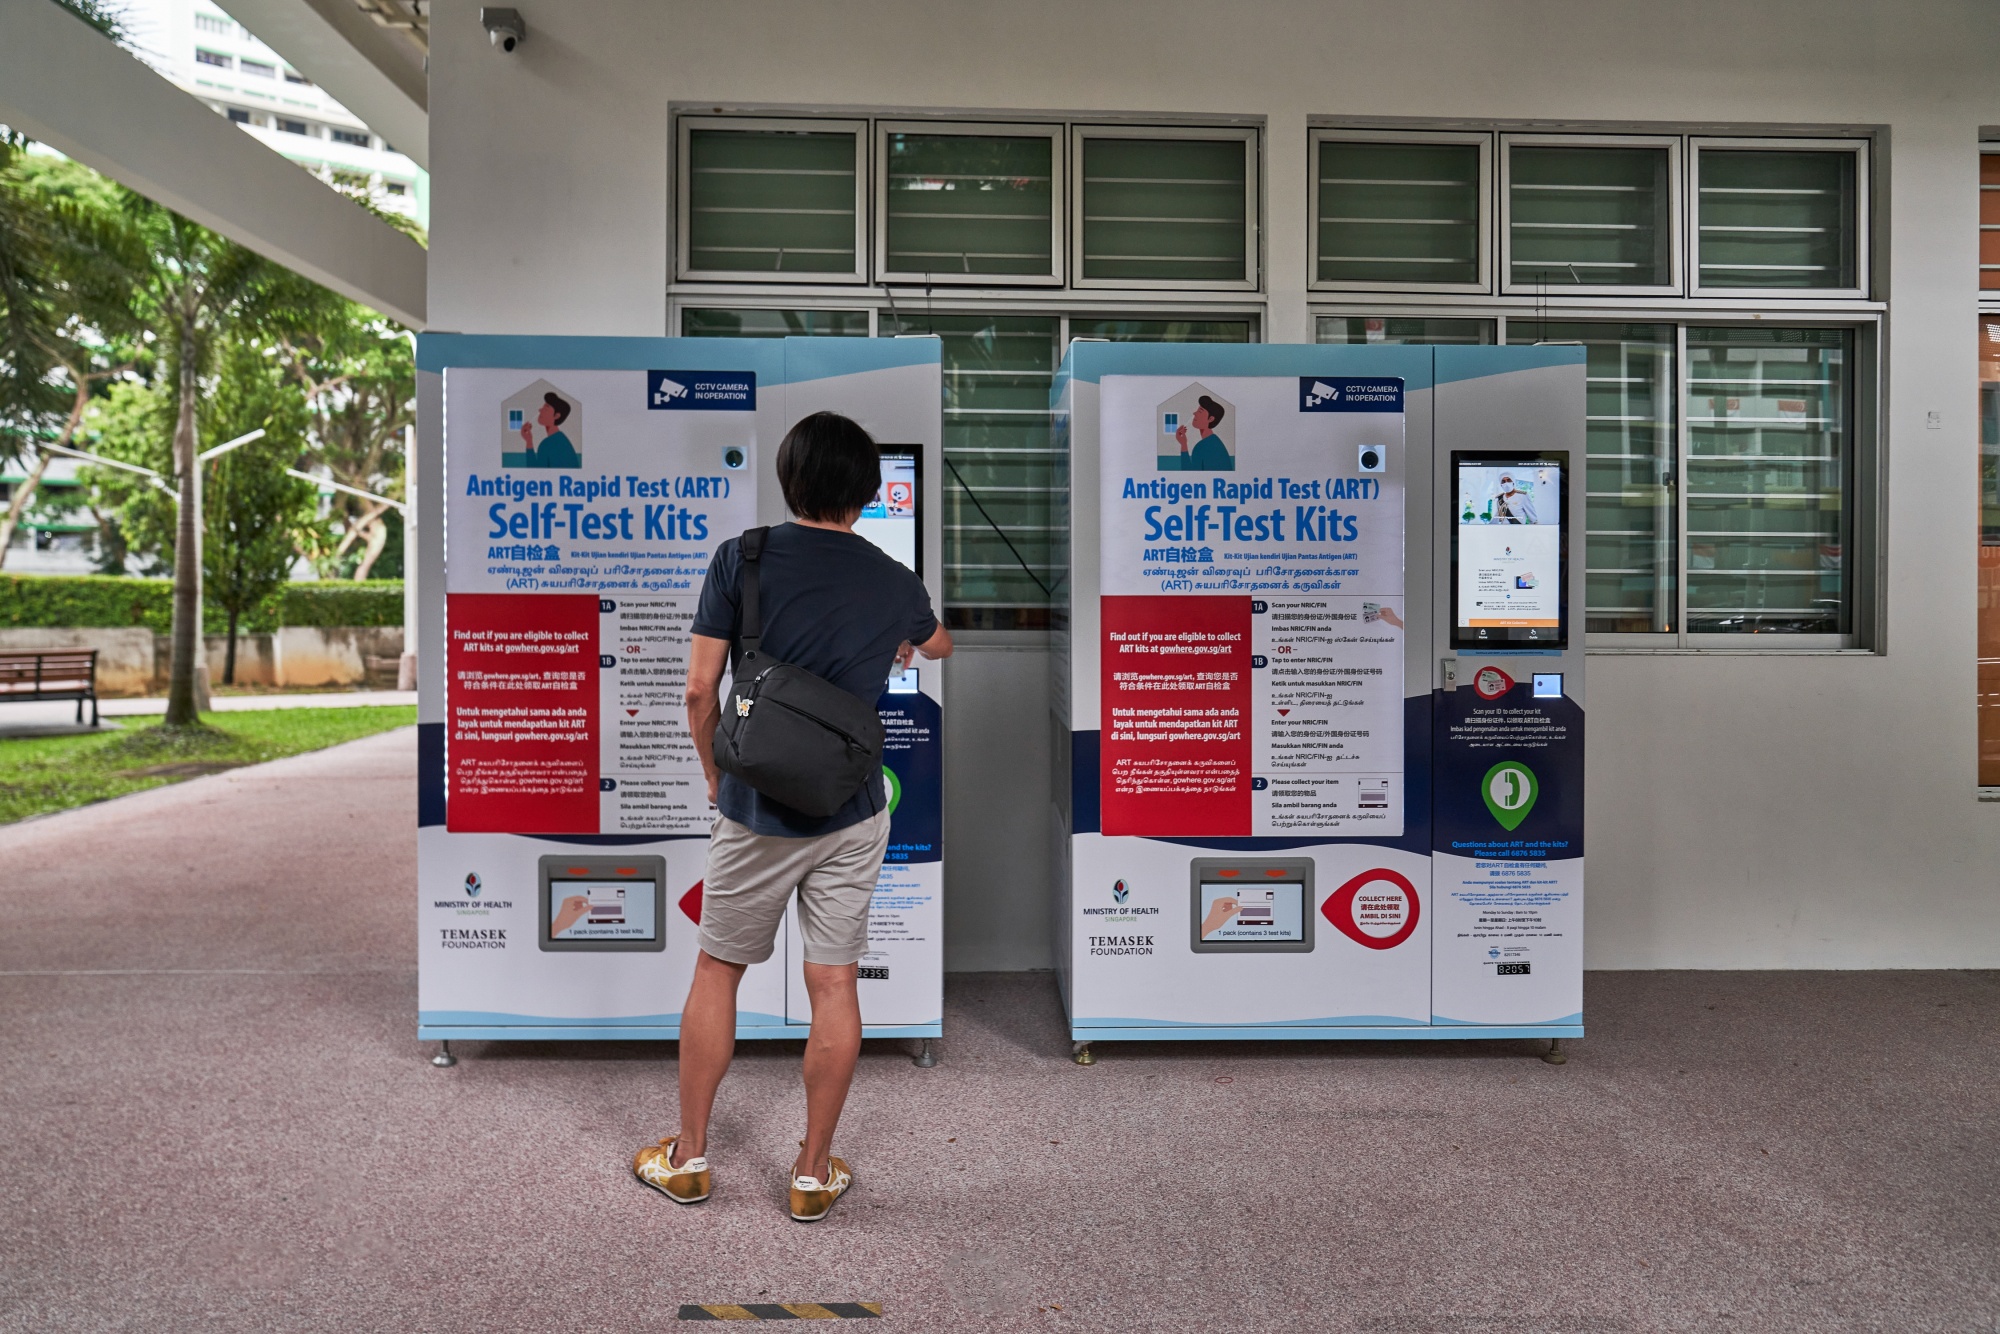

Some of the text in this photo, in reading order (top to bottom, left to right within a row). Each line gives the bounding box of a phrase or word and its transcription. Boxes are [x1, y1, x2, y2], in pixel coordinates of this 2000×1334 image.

[695, 383, 716, 393] CCTV
[704, 392, 746, 400] OPERATION
[467, 474, 730, 502] Antigen Rapid Test (ART)
[1123, 477, 1379, 504] Antigen Rapid Test (ART)
[489, 504, 708, 540] Self-Test Kits
[1145, 505, 1358, 542] Self-Test Kits
[488, 544, 560, 561] ART自检盒
[1143, 547, 1214, 563] ART自检盒
[1282, 553, 1297, 561] Ujian
[1319, 553, 1342, 561] Antigen
[1162, 580, 1192, 592] (ART)
[454, 630, 471, 640] Find
[472, 632, 485, 640] out
[487, 630, 493, 640] if
[494, 633, 508, 642] you
[524, 631, 552, 642] eligible
[554, 632, 562, 640] to
[564, 631, 588, 640] collect
[1110, 632, 1126, 641] Find
[1128, 633, 1141, 641] out
[1142, 632, 1148, 641] if
[1149, 634, 1163, 643] you
[1178, 632, 1206, 643] eligible
[1217, 632, 1241, 640] collect
[464, 641, 579, 654] ART kits at gowhere.gov.sg/art
[1119, 644, 1232, 655] ART kits at gowhere.gov.sg/art
[1112, 708, 1135, 716] Untuk
[1137, 708, 1182, 718] mengetahui
[1205, 708, 1219, 716] ada
[1220, 708, 1239, 716] anda
[1114, 720, 1238, 730] layak untuk mendapatkan kit ART
[1111, 731, 1240, 742] di sini, lungsuri gowhere.gov.sg/art
[1105, 914, 1137, 922] SINGAPORE
[441, 930, 506, 939] TEMASEK
[1223, 930, 1236, 938] pack
[442, 941, 505, 949] FOUNDATION
[1089, 936, 1154, 946] TEMASEK
[1091, 948, 1152, 956] FOUNDATION
[1498, 965, 1531, 974] 82057
